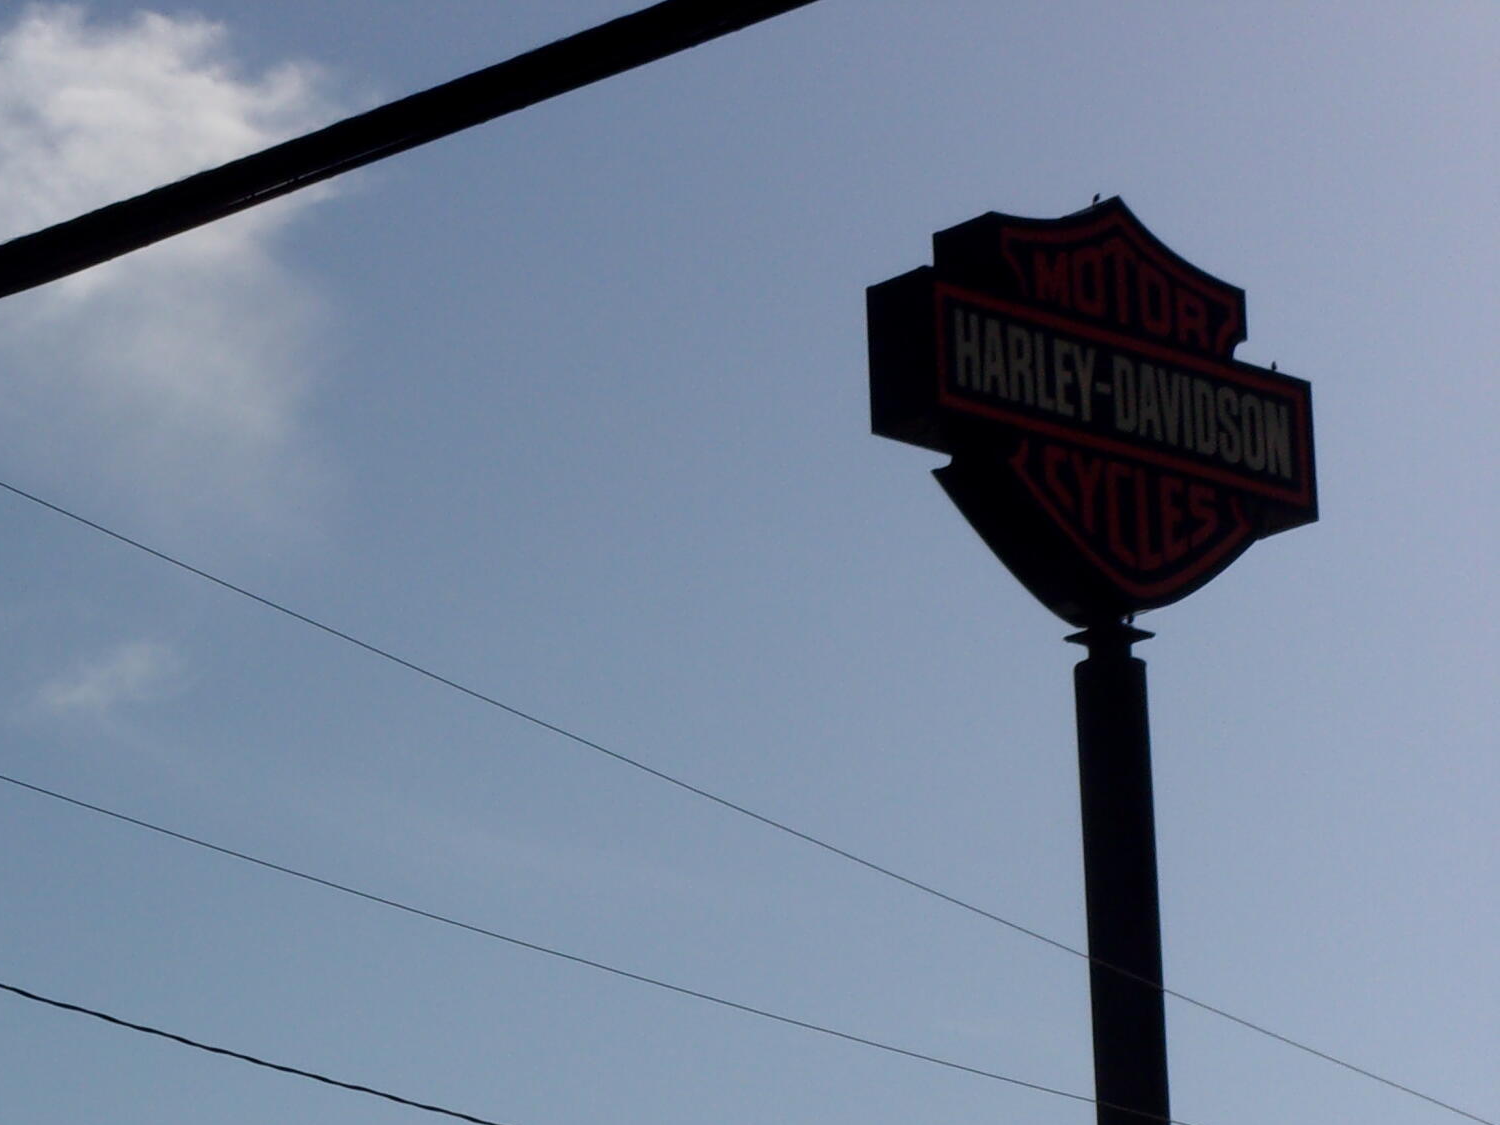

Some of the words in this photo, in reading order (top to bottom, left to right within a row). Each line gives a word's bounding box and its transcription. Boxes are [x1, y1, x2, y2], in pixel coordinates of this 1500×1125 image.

[1032, 237, 1210, 350] MOTOR
[952, 306, 1294, 480] HARLEY-DAVIDSON
[1044, 443, 1219, 572] CYCLES
